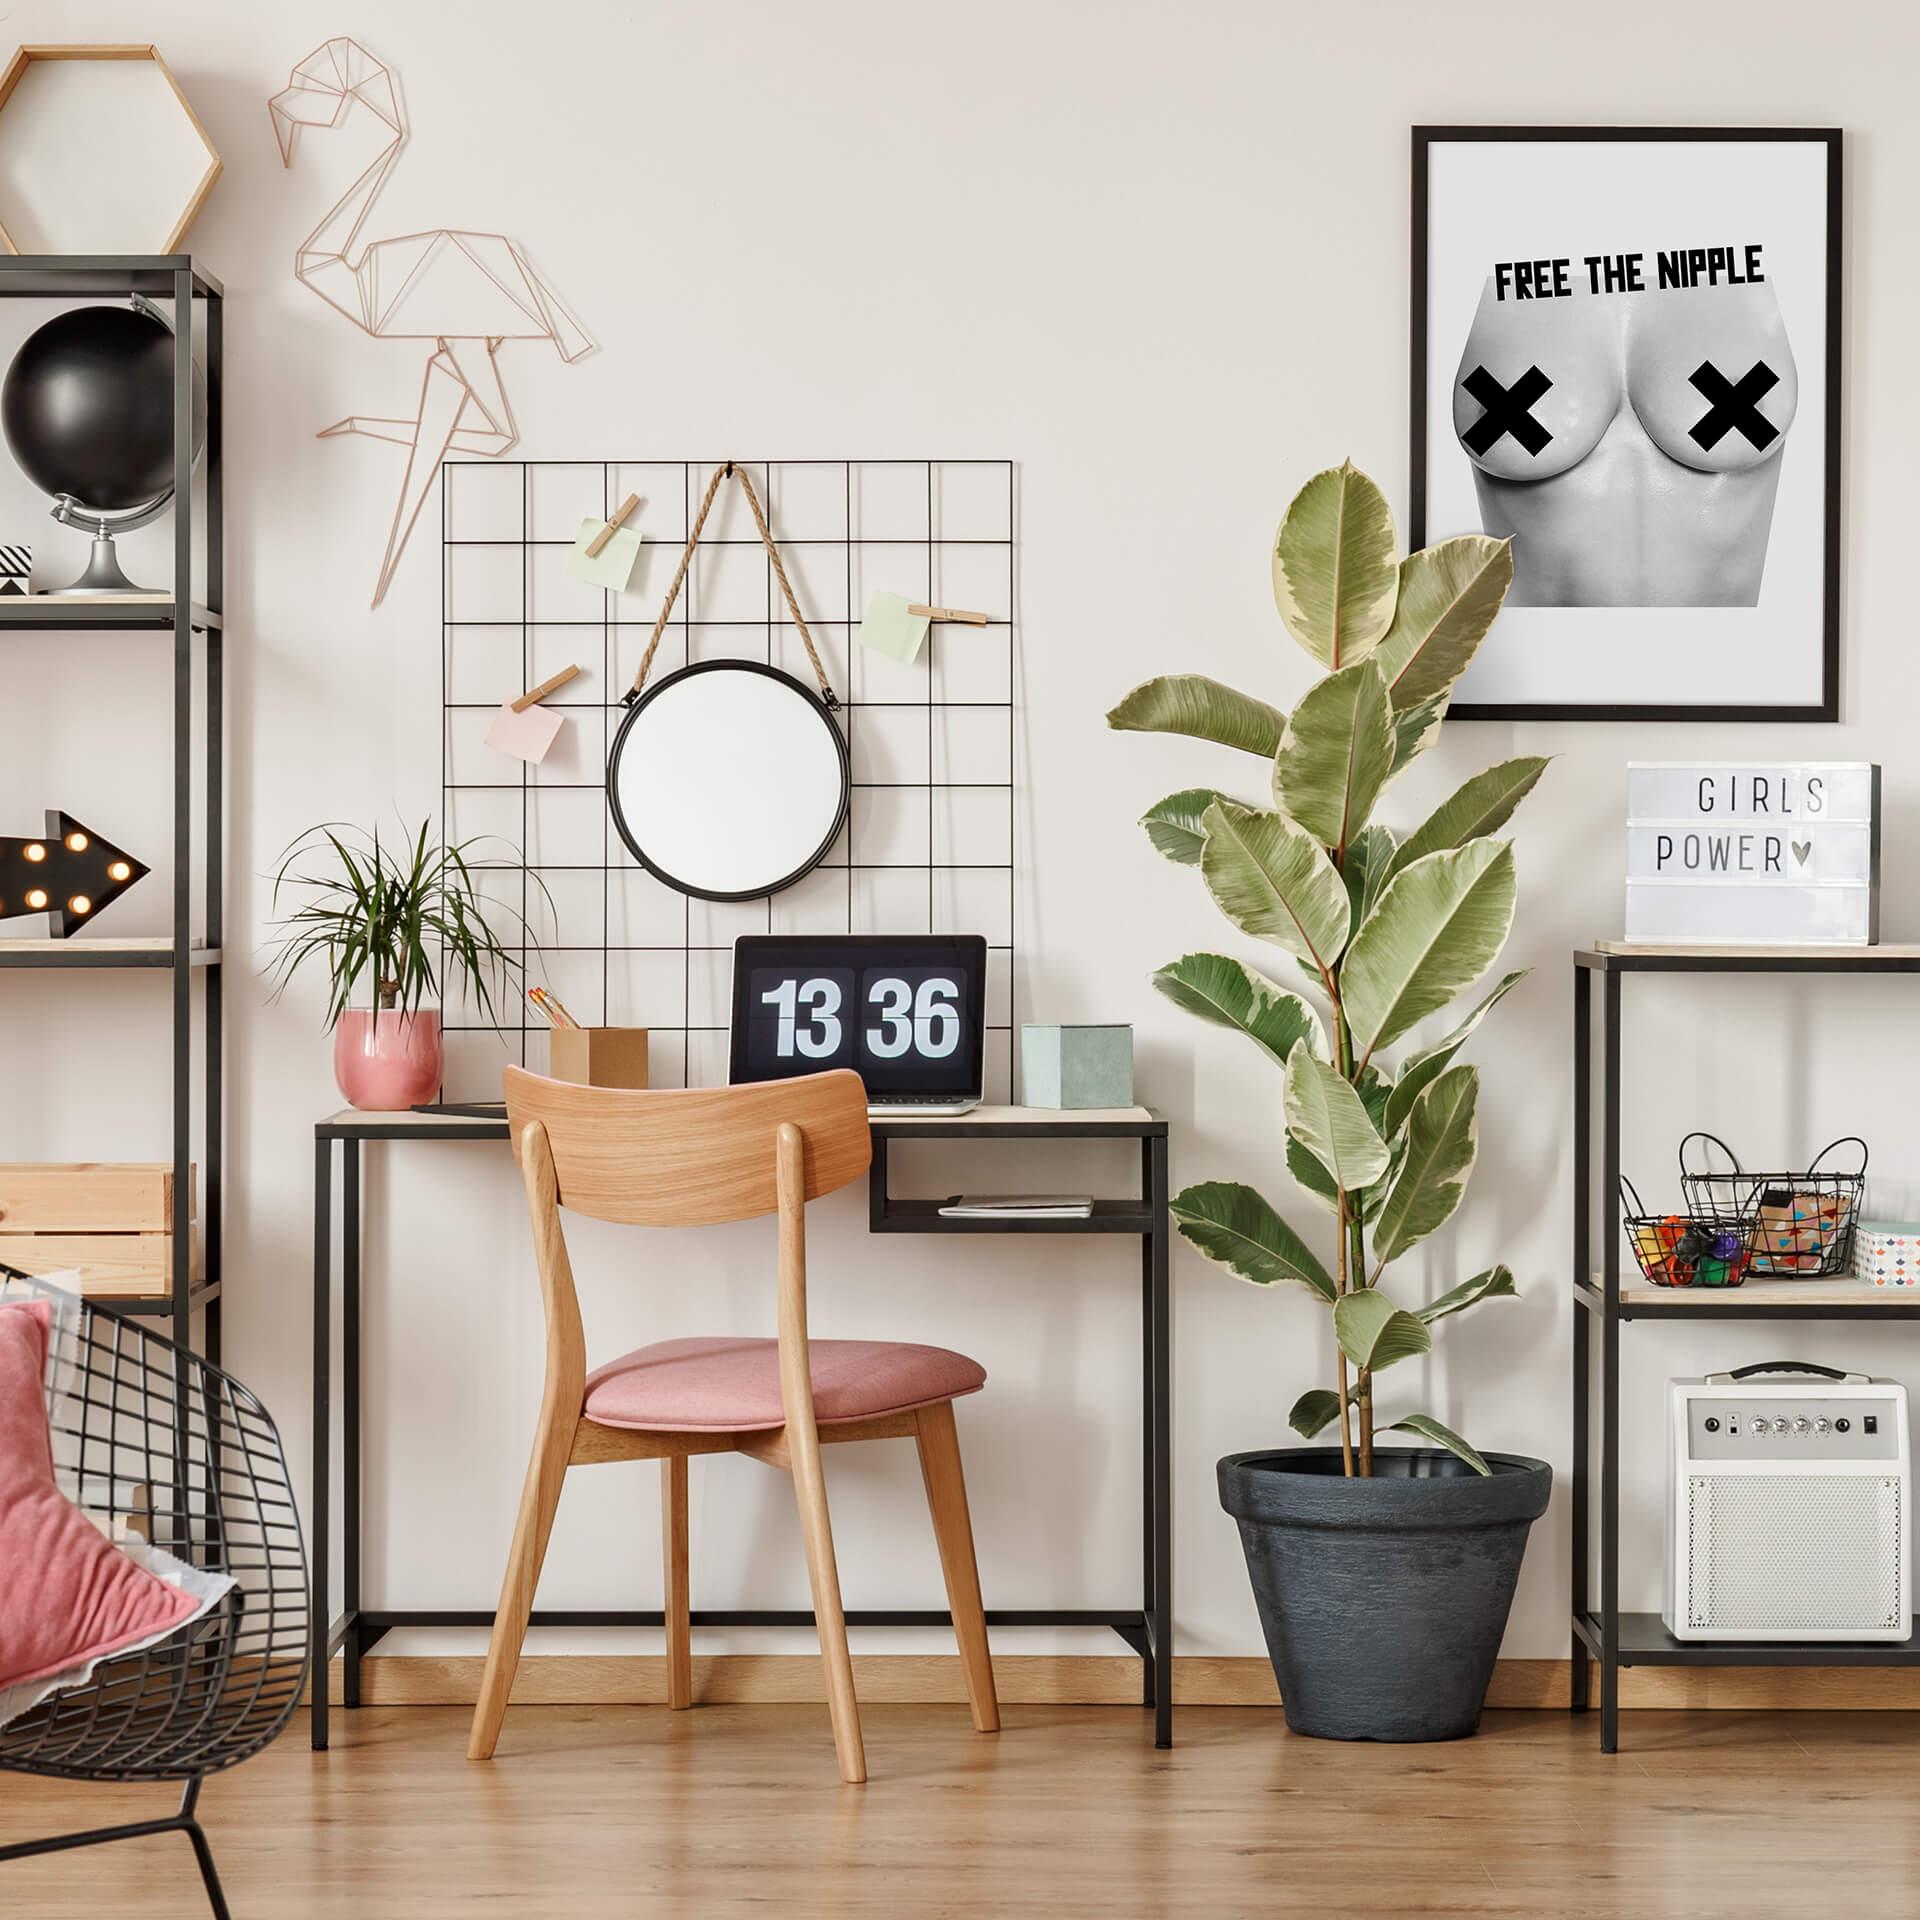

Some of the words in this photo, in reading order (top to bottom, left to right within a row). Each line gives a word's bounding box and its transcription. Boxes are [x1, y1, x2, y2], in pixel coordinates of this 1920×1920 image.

[1495, 259, 1572, 301] FREE
[1584, 253, 1645, 294] THE
[1656, 244, 1765, 289] NIPPLE
[1698, 776, 1823, 813] GIRLS
[1656, 834, 1782, 872] POWER
[762, 977, 842, 1058] 13
[866, 977, 960, 1058] 36
